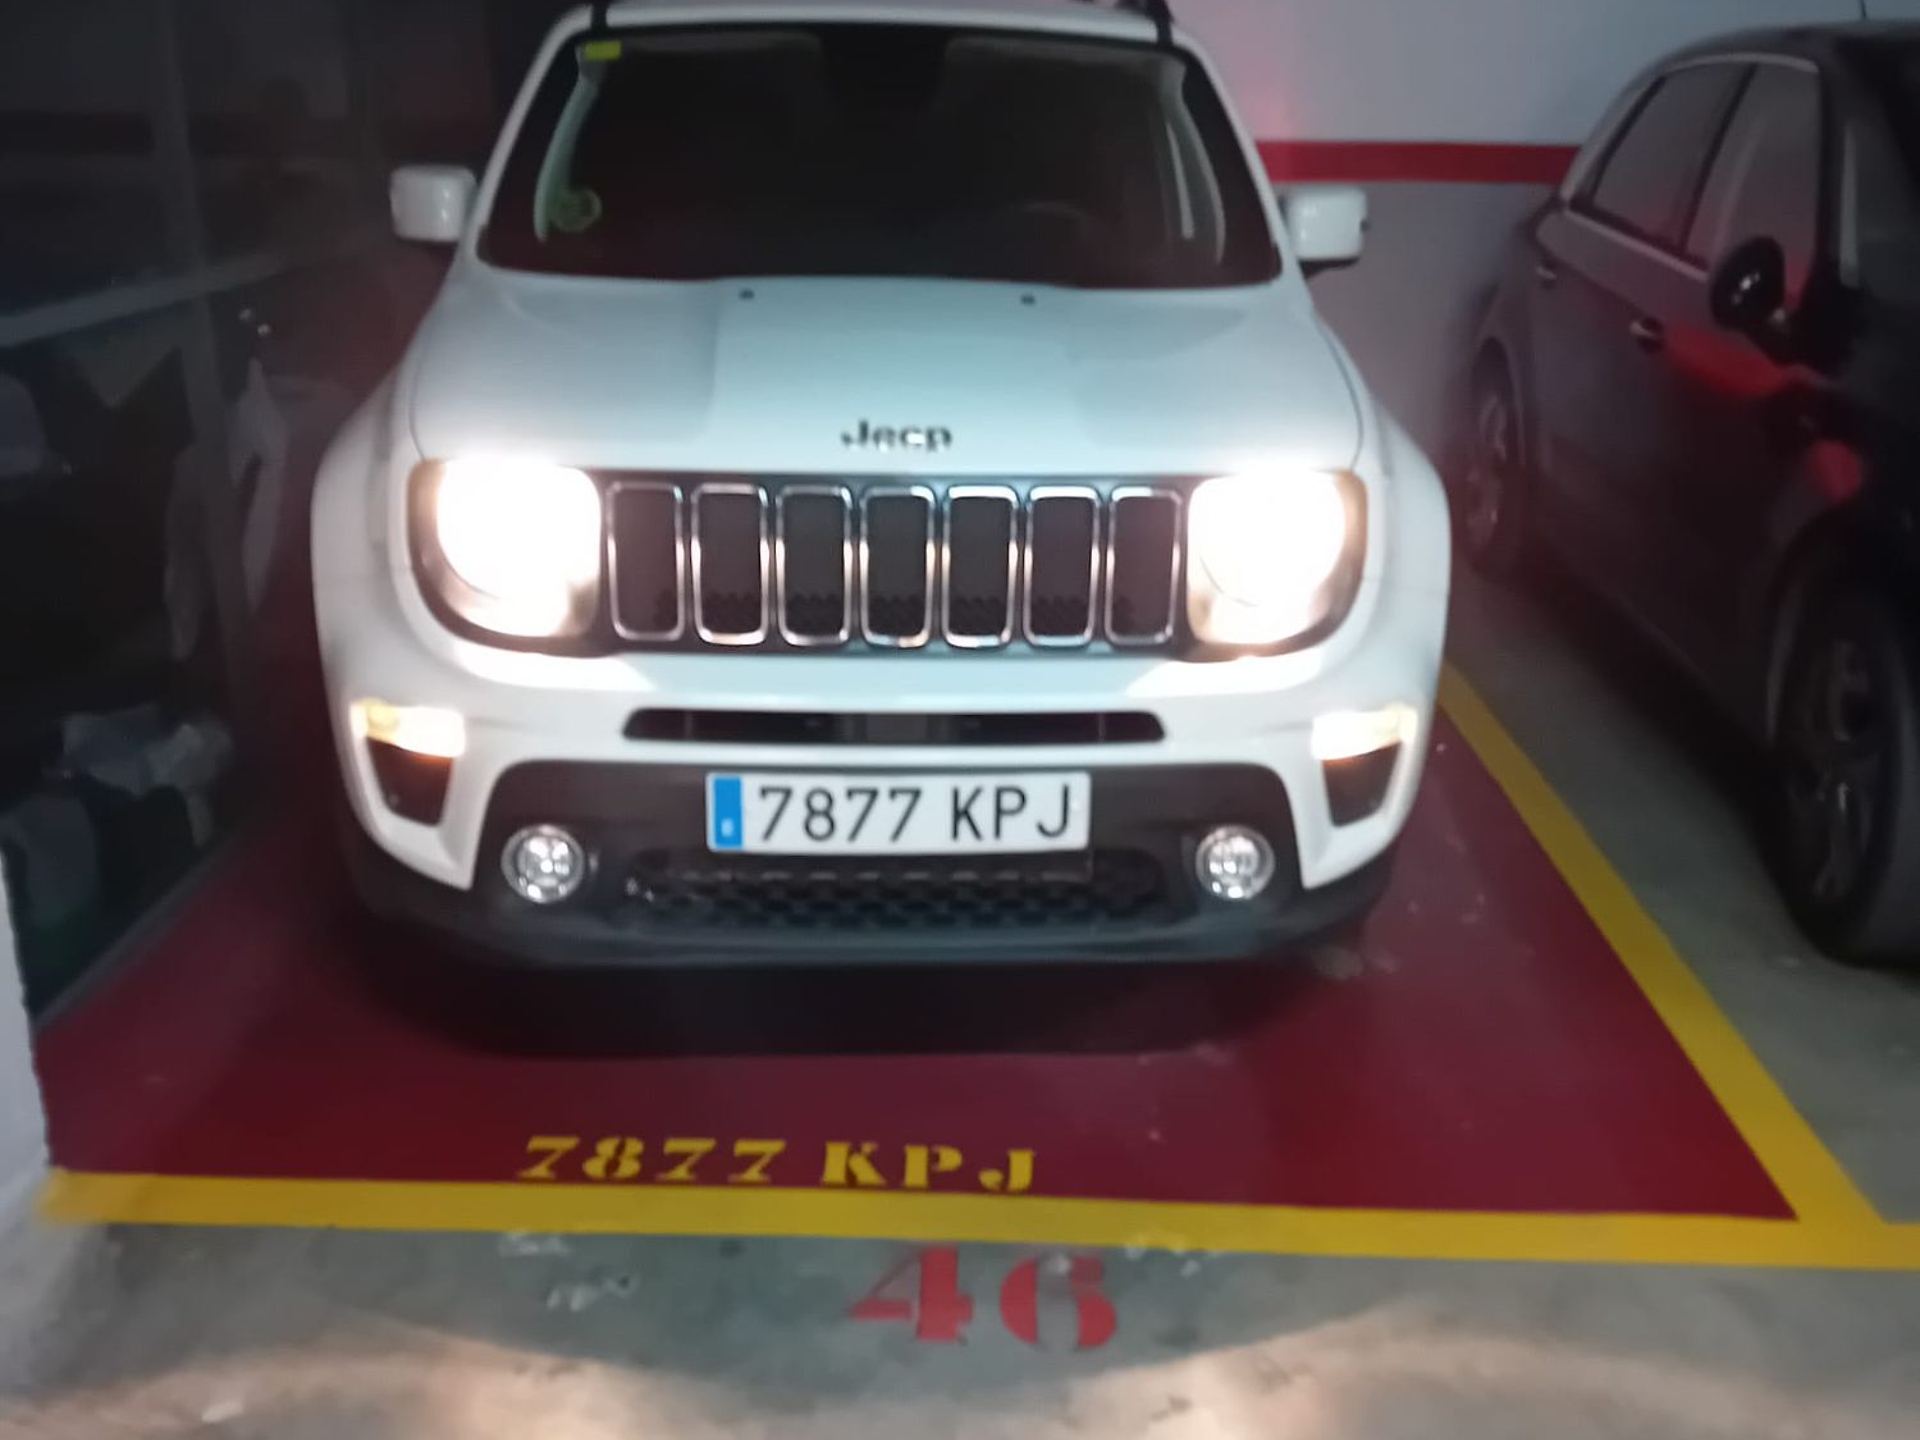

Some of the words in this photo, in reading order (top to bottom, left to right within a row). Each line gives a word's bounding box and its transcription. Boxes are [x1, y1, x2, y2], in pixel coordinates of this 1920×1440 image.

[840, 418, 953, 452] Jeep
[759, 785, 922, 842] 7877
[950, 783, 1071, 841] KPJ
[517, 1135, 787, 1183] 7877
[821, 1140, 1035, 1192] KPJ
[846, 1243, 1118, 1349] 46
